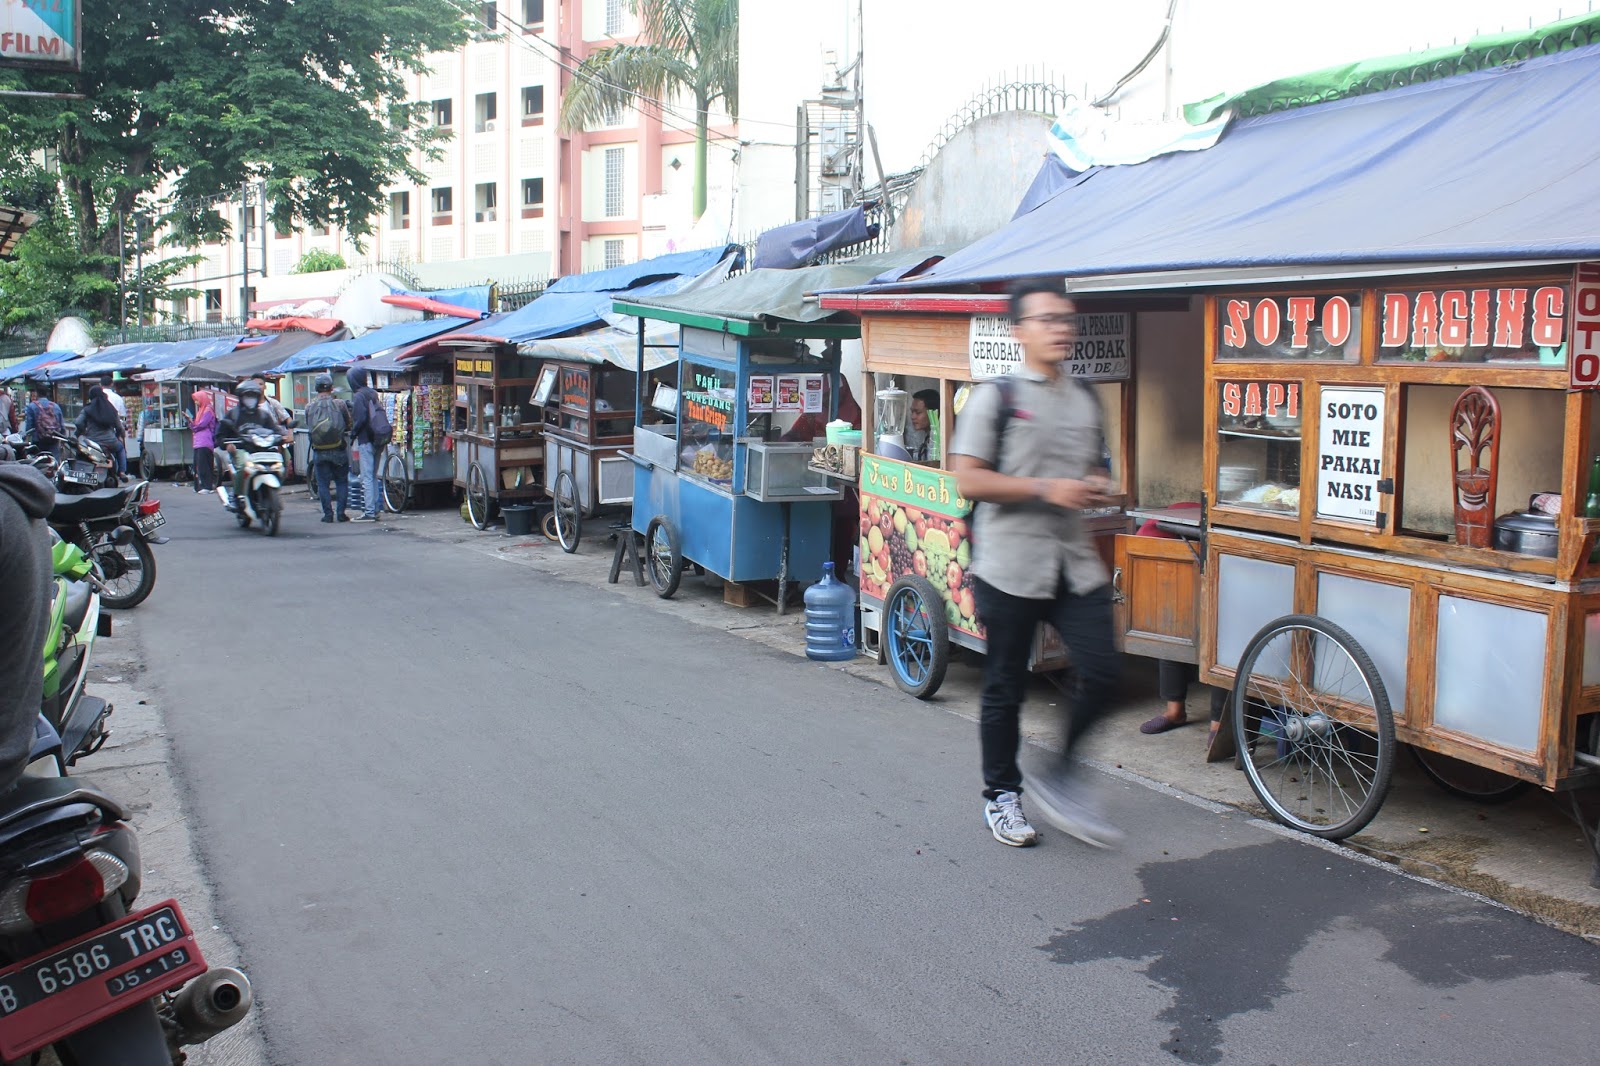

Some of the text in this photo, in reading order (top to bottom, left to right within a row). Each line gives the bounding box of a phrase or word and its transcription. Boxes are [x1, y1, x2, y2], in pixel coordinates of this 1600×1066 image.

[1, 32, 59, 55] FILM
[1089, 315, 1124, 335] PESANAN
[1223, 286, 1564, 349] SOTO DAGING
[972, 341, 1022, 361] GEROBAK
[1064, 339, 1126, 360] EROBAK
[1093, 362, 1112, 373] DE
[695, 373, 721, 391] TAHU
[686, 390, 731, 411] SUMEDANG
[1222, 382, 1299, 418] SAPI
[1327, 402, 1378, 421] SOTO
[1332, 429, 1371, 448] MIE
[1321, 454, 1381, 475] PAKAI
[868, 461, 898, 492] Jus
[903, 468, 950, 504] Buah
[1327, 481, 1372, 502] NASI
[0, 916, 176, 1013] B 6586 TRG
